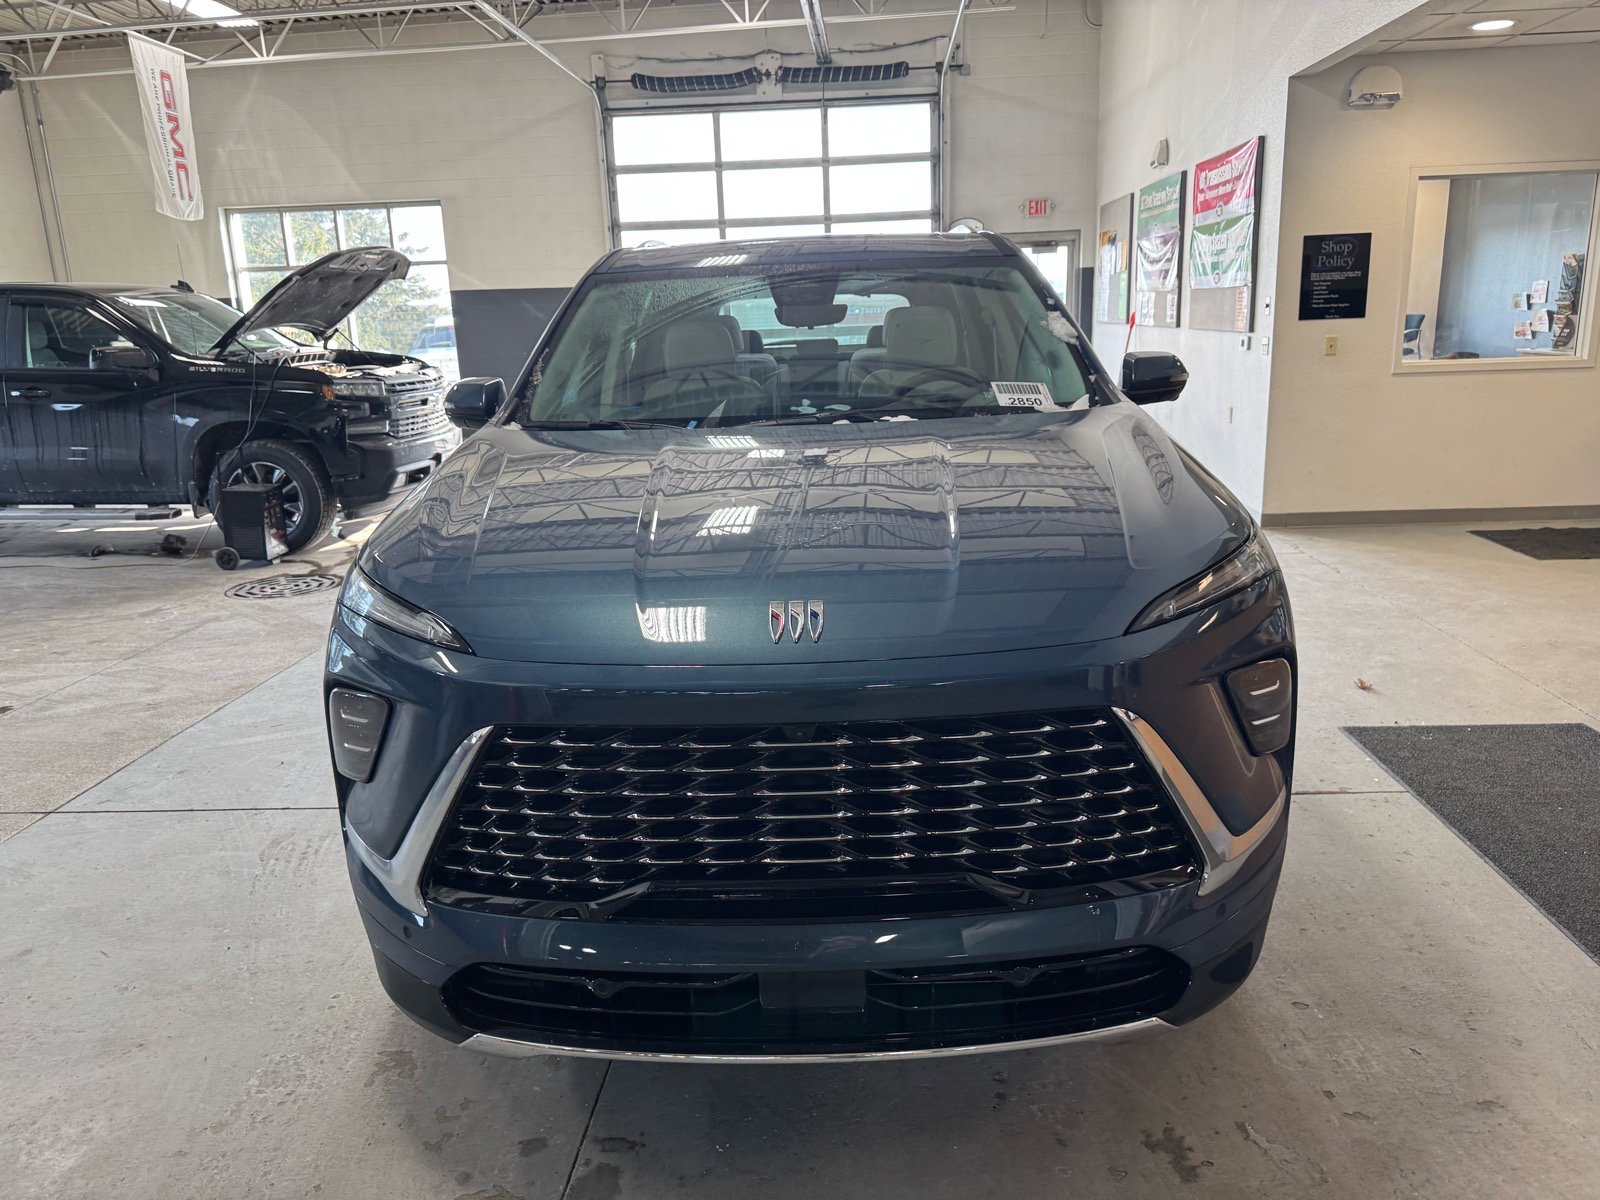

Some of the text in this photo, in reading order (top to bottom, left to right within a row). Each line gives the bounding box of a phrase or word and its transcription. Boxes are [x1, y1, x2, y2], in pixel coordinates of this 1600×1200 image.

[150, 68, 157, 81] WE
[157, 103, 171, 168] PROFESSIONAL
[160, 69, 193, 202] GMC
[1028, 199, 1048, 216] EXIT
[1321, 240, 1353, 255] Shop
[1318, 255, 1355, 270] Policy
[188, 366, 246, 374] SILVERADO
[1008, 397, 1043, 406] 2850
